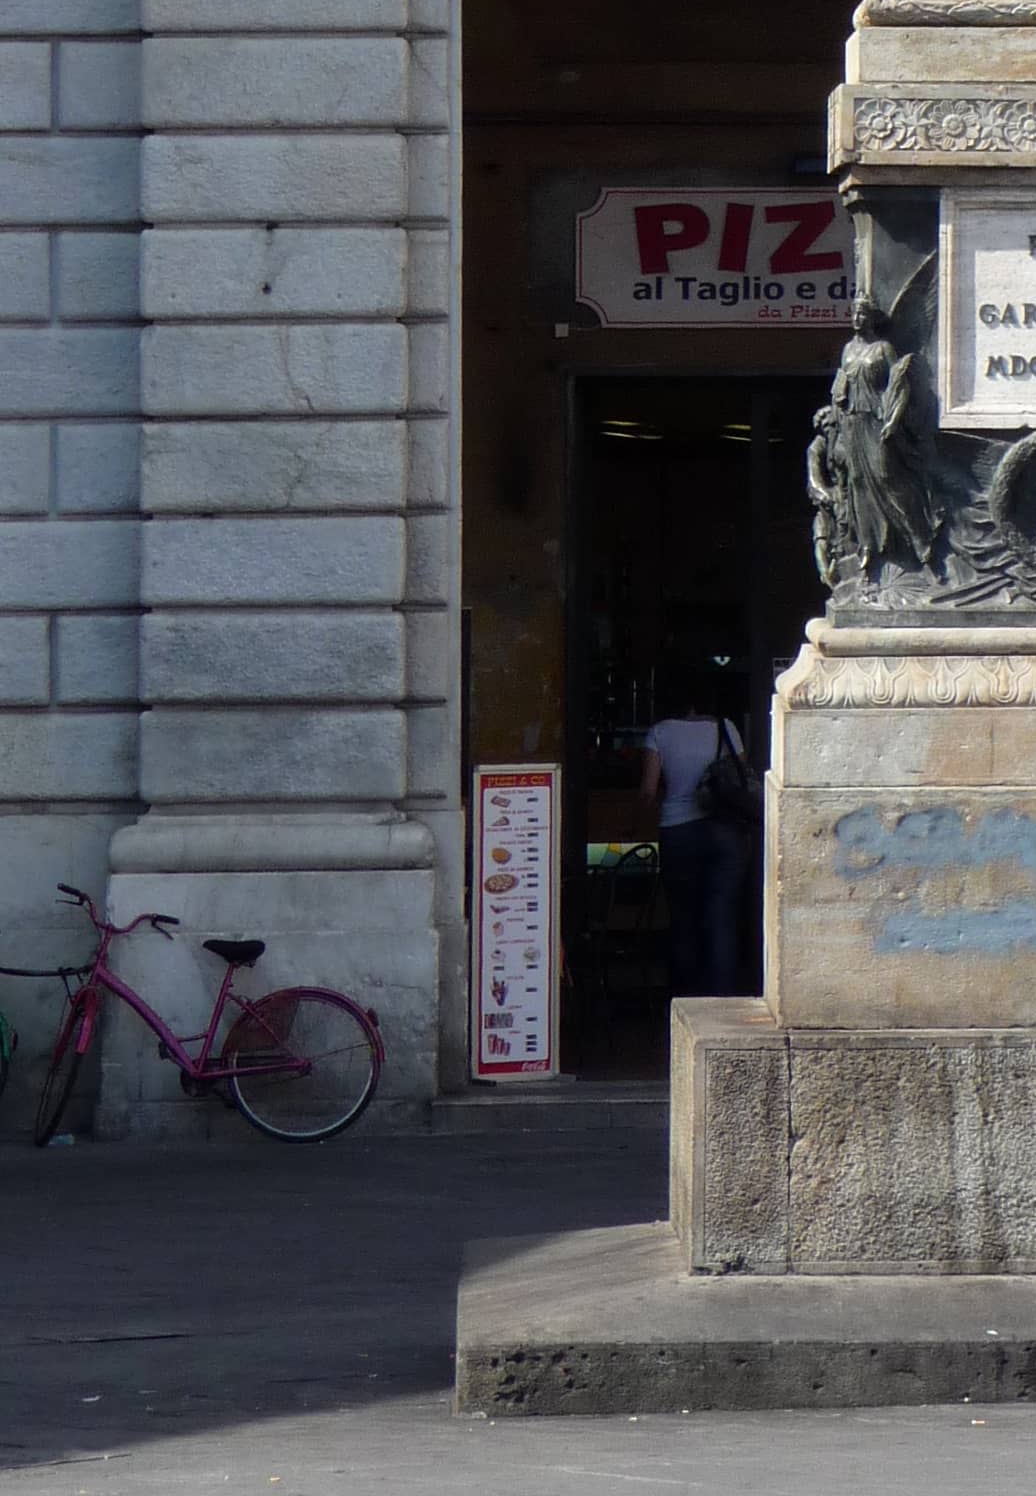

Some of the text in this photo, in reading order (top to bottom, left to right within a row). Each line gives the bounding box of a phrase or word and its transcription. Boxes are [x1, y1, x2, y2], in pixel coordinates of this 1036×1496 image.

[633, 276, 662, 301] al
[675, 276, 784, 306] Taglio
[796, 282, 815, 301] e
[759, 305, 782, 318] da
[790, 305, 837, 318] Pizzi
